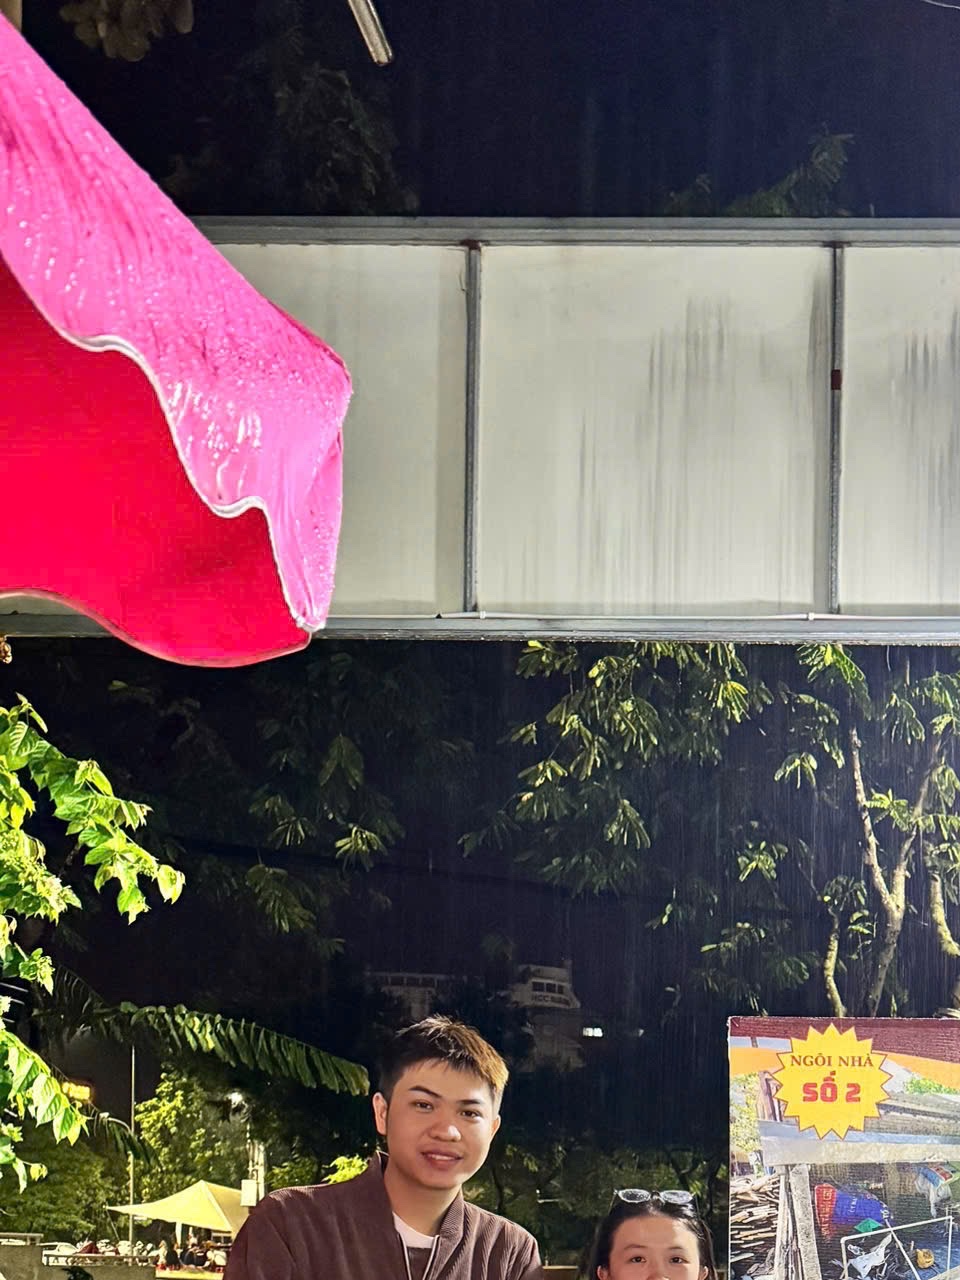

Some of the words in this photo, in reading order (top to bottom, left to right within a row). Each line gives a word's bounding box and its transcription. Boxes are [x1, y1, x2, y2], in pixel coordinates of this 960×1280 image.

[790, 1053, 832, 1067] NGÔI
[838, 1053, 874, 1067] NHÀ
[802, 1070, 838, 1103] SỐ
[845, 1082, 861, 1103] 2
